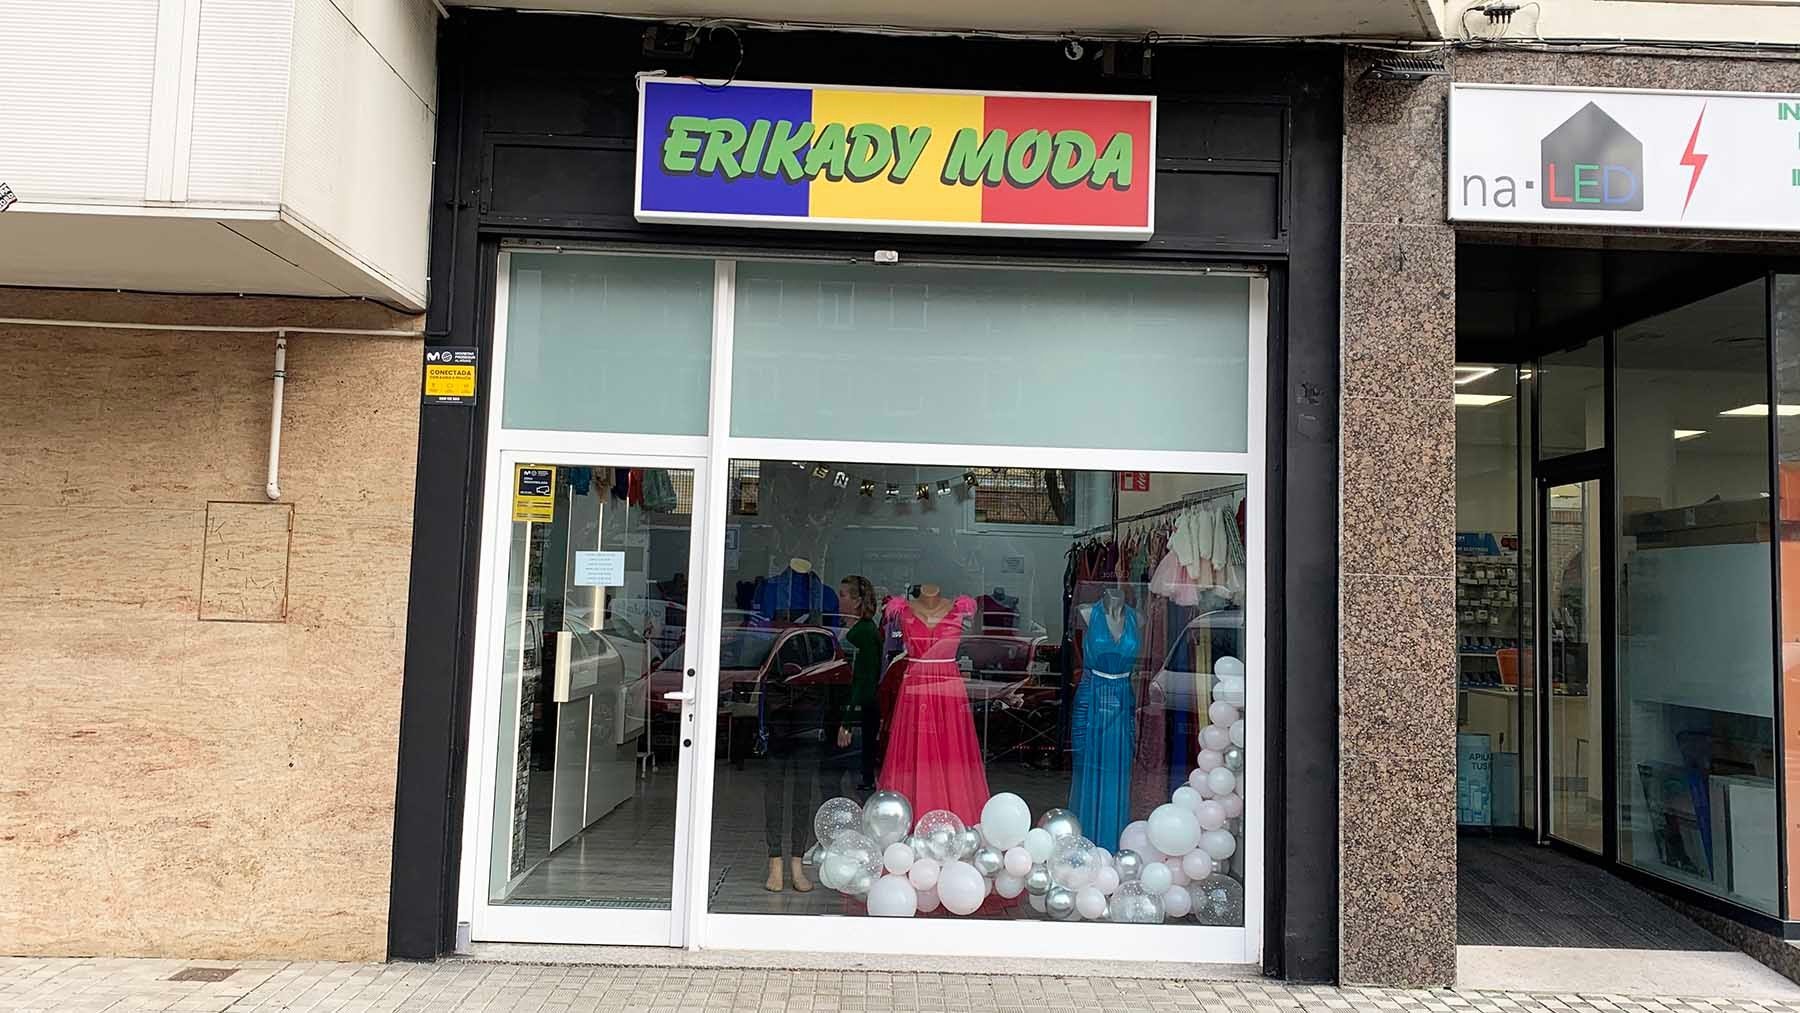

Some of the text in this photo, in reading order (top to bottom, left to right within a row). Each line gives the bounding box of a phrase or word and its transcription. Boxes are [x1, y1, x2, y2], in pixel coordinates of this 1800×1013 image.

[662, 115, 1134, 190] ERIKADY MODA
[1547, 162, 1637, 205] LED
